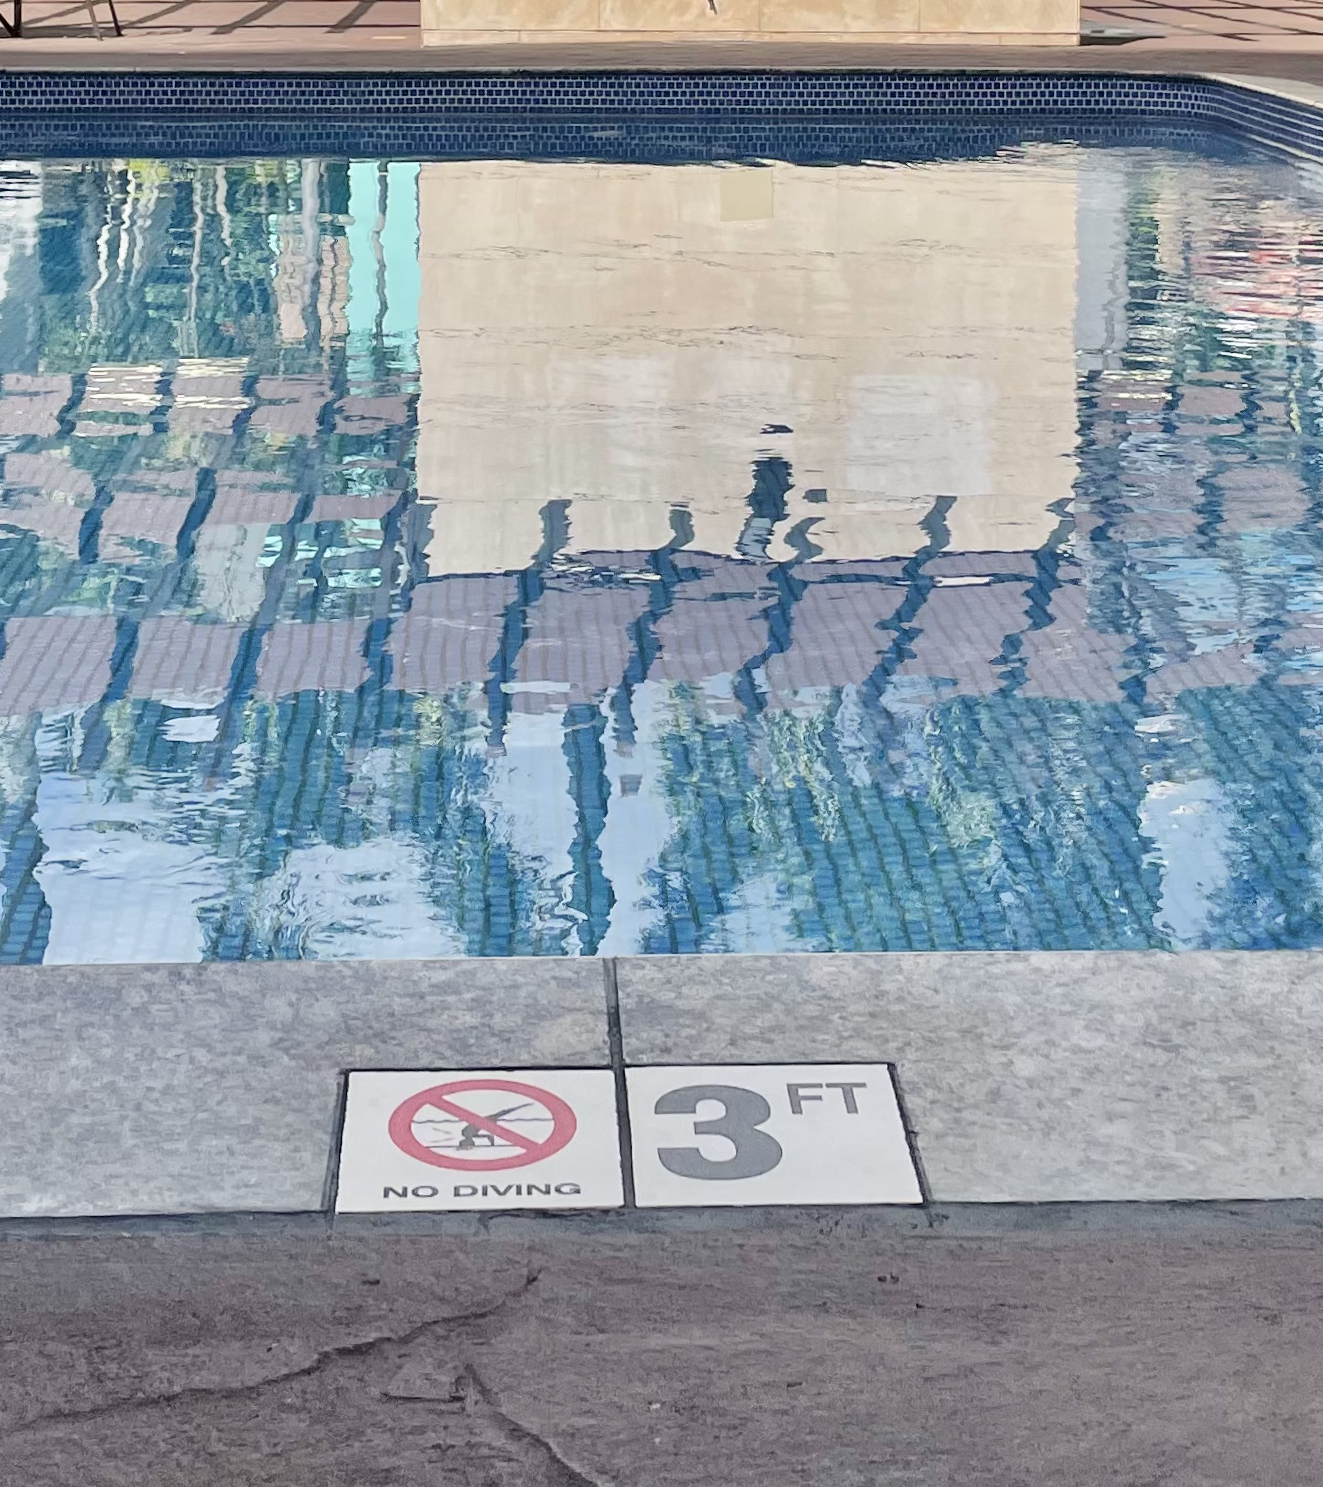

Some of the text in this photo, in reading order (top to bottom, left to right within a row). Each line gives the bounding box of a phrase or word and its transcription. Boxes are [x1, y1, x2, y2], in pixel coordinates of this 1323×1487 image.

[654, 1082, 867, 1180] 3 FT
[383, 1182, 582, 1198] NO DIVING
